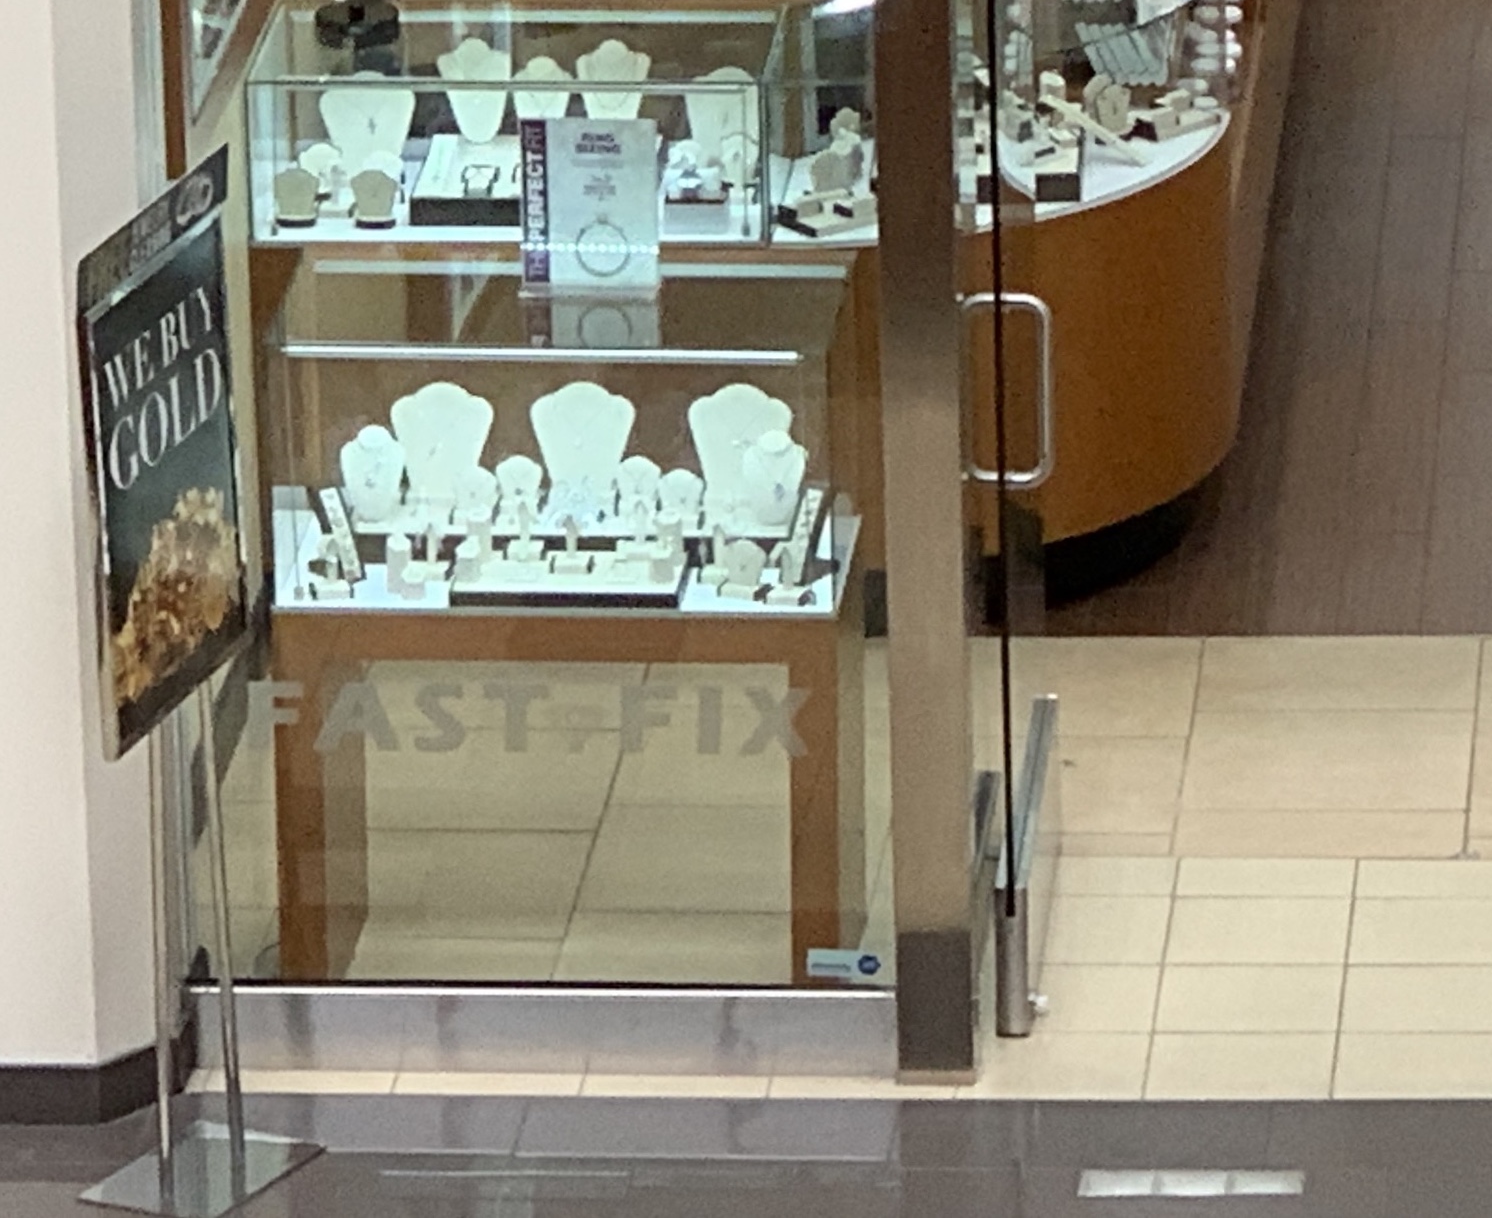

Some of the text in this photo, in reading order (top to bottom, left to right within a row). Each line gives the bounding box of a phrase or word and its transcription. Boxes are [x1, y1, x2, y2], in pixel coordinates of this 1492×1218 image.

[526, 152, 545, 241] PERFECT
[102, 286, 215, 410] WE BUY
[109, 348, 221, 490] GOLD
[244, 680, 812, 758] FAST FIX
